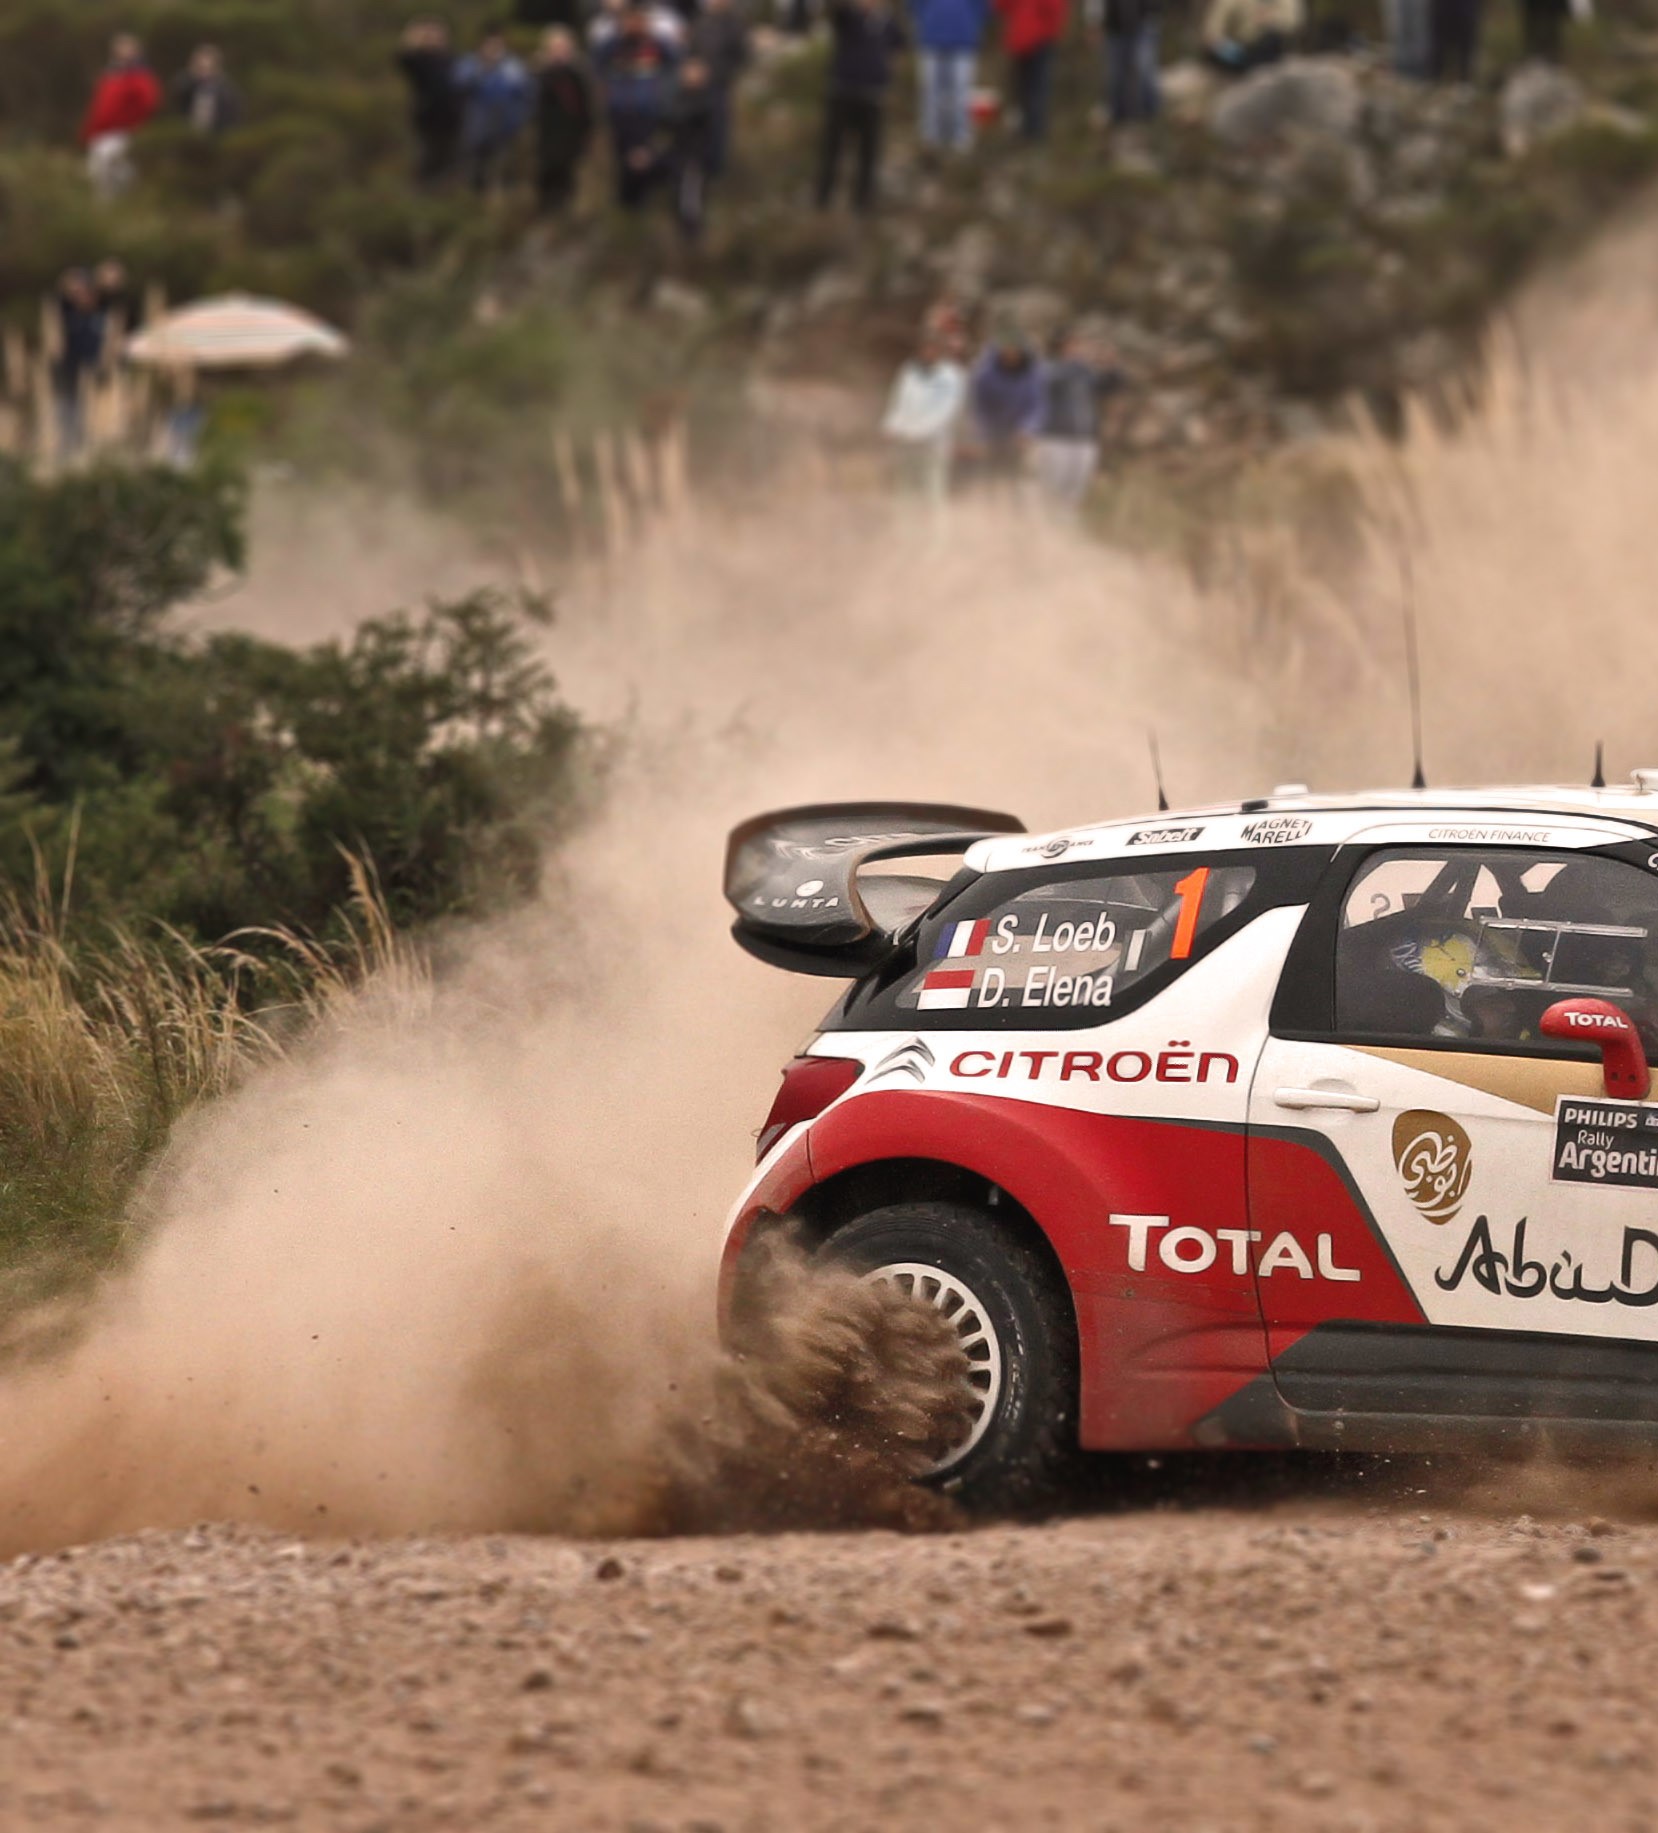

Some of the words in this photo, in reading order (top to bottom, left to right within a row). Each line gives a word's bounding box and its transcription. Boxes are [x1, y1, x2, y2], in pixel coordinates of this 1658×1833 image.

[1490, 829, 1552, 843] FINANCE
[752, 896, 840, 909] LUHTA
[1170, 866, 1210, 959] 1
[991, 913, 1020, 955] S.
[1032, 910, 1116, 953] Loeb
[977, 967, 1010, 1008] D.
[1021, 965, 1115, 1008] Elena
[1563, 1011, 1628, 1029] TOTAL
[1563, 1107, 1638, 1128] PHILIPS
[1577, 1129, 1614, 1148] Rally
[1109, 1213, 1361, 1281] TOTAL
